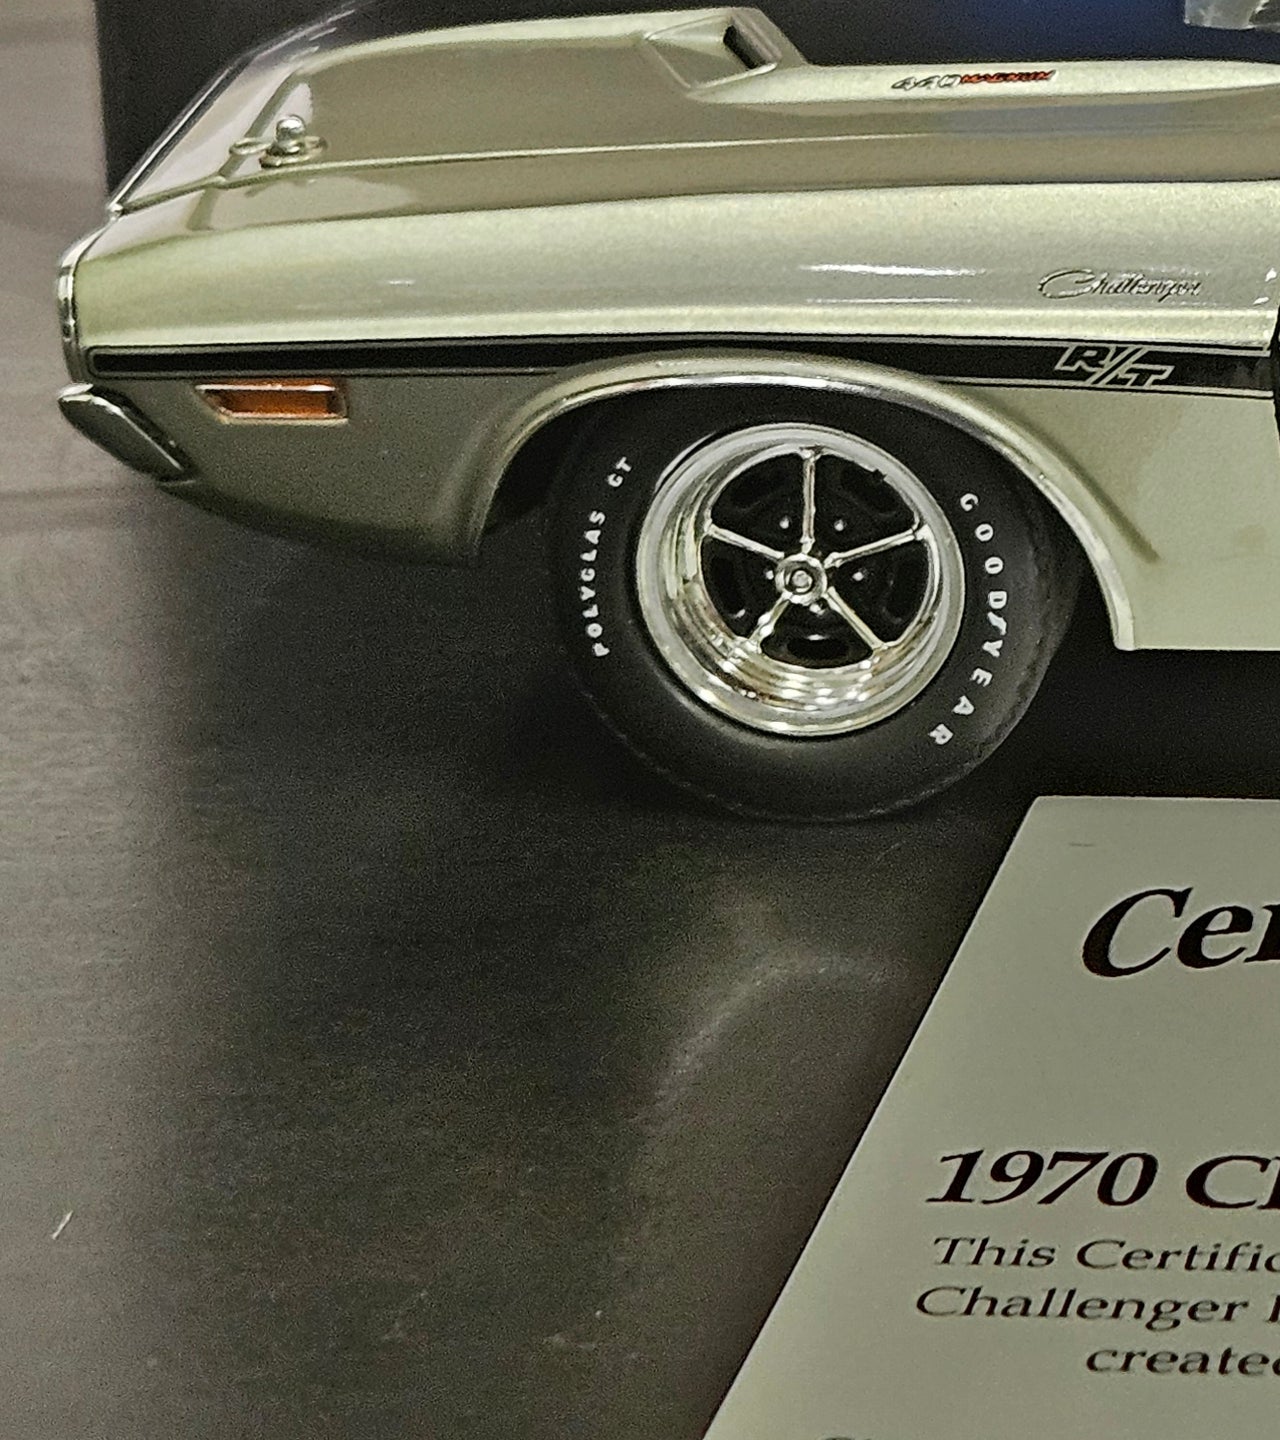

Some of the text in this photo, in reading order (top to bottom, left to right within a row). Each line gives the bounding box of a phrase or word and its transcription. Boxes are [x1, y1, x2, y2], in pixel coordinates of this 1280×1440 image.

[1053, 344, 1176, 388] R/T
[606, 456, 633, 490] GT
[928, 492, 1009, 747] GOODYEAR
[925, 1148, 1160, 1208] 1970
[932, 1237, 1055, 1267] This
[916, 1286, 1249, 1331] Challenger
